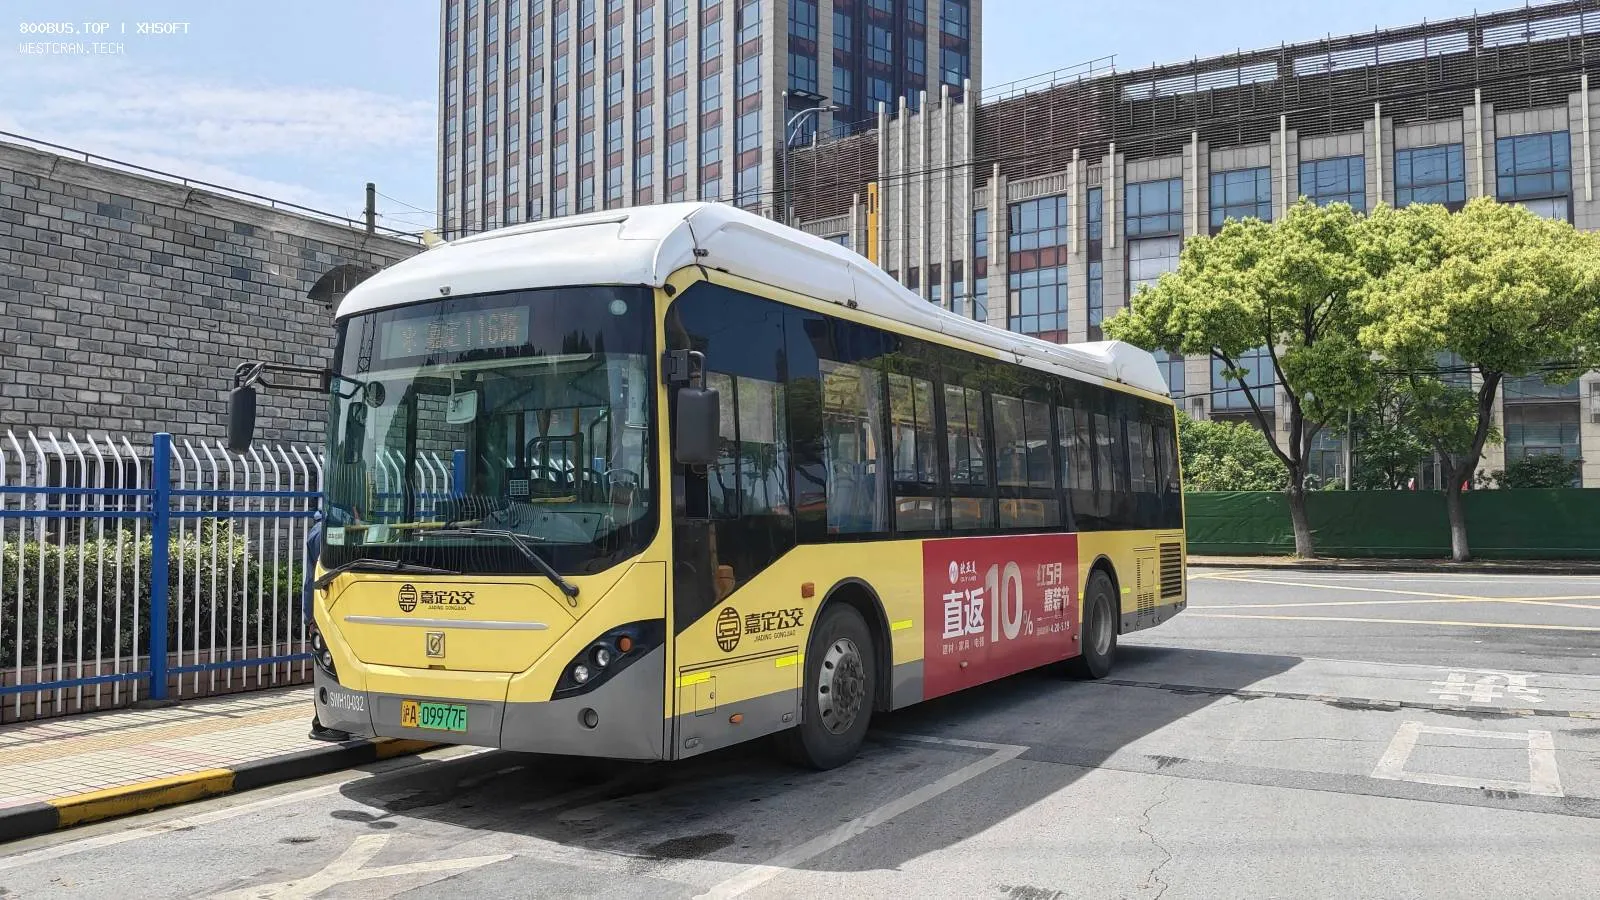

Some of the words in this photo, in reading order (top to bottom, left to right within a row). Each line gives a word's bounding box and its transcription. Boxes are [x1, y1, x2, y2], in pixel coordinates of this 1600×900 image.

[420, 590, 475, 605] 嘉定公交
[744, 608, 804, 635] 嘉定公交
[943, 587, 984, 639] 直返
[329, 691, 365, 712] SWH10-032
